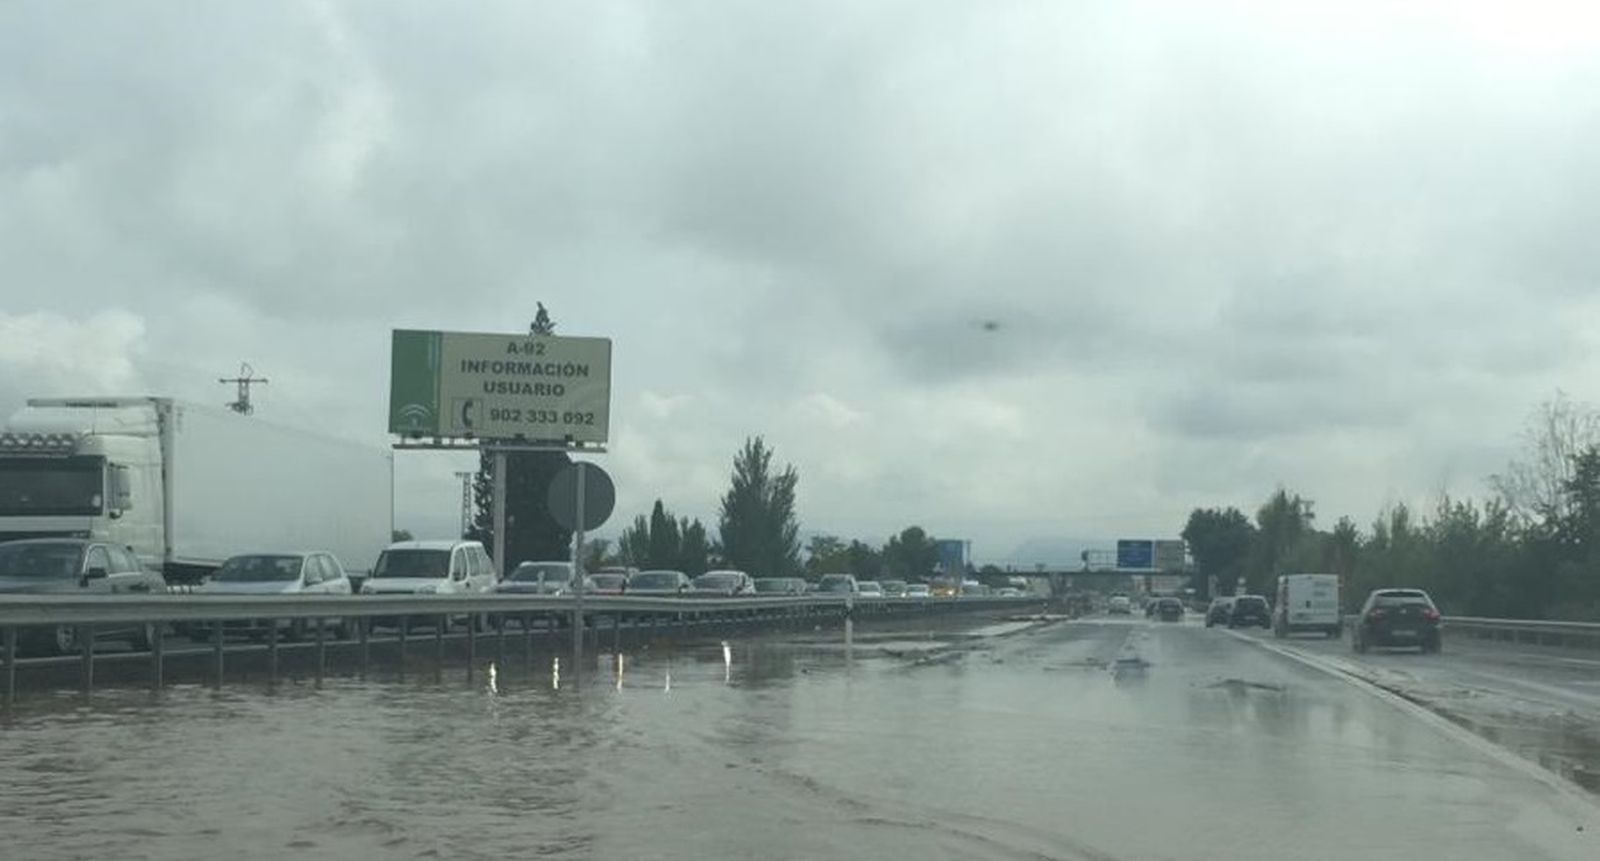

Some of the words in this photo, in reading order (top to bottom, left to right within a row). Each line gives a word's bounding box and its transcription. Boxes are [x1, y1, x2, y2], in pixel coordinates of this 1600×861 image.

[461, 359, 589, 377] INFORMACIÓN
[483, 382, 566, 397] USUARIO
[490, 408, 522, 423] 902
[525, 410, 558, 424] 333
